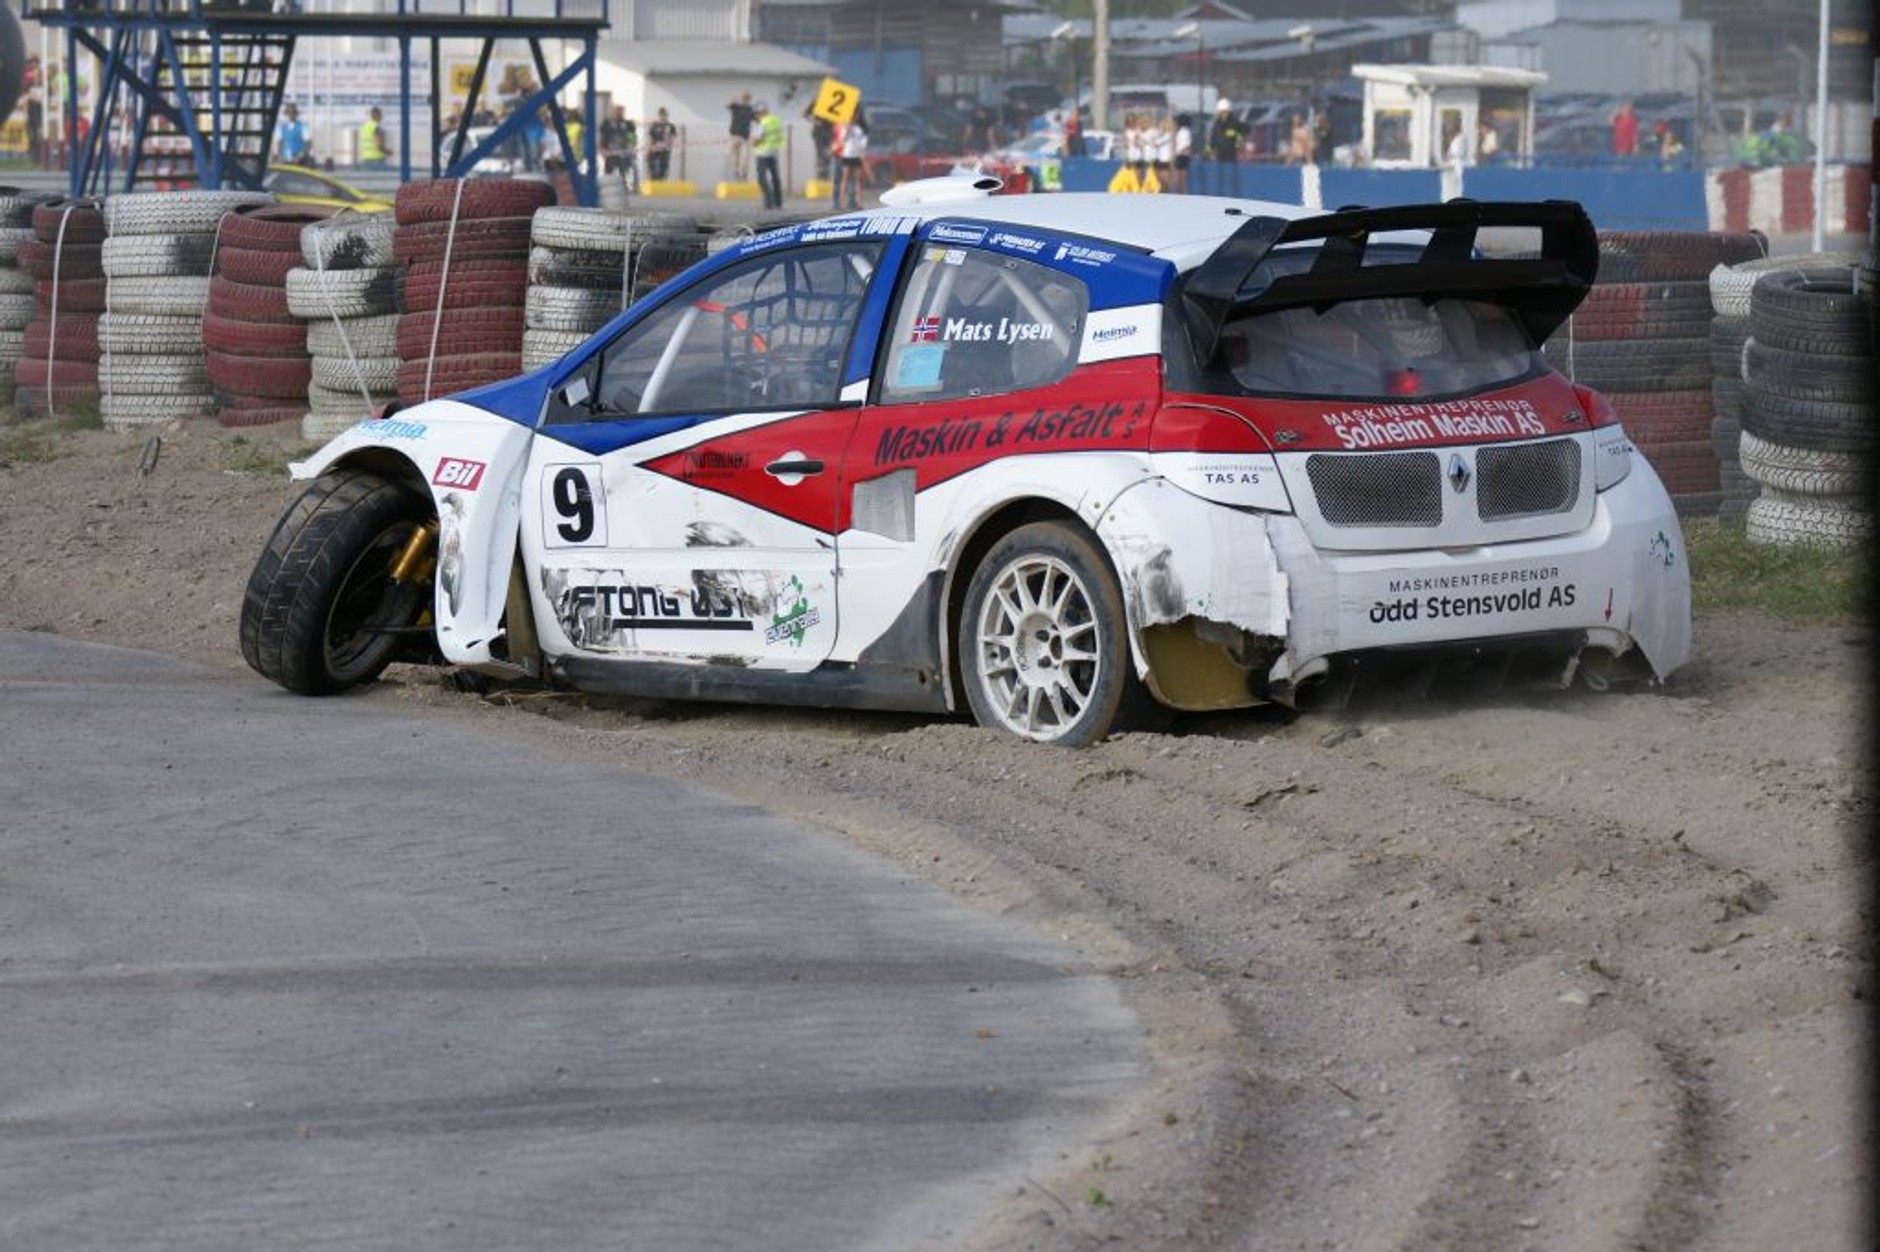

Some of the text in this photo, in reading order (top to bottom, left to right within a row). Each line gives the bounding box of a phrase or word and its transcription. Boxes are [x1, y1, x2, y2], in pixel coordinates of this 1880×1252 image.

[827, 90, 846, 117] 2
[943, 317, 1053, 345] Mats Lysen
[1322, 400, 1534, 427] MASKINENTREPRENØR
[874, 416, 984, 466] Maskin
[985, 411, 1015, 448] &
[1014, 403, 1125, 443] Asfalt
[1335, 411, 1545, 449] Solheim Maskin AS
[436, 460, 477, 487] Bil
[1205, 473, 1259, 484] TAS AS
[553, 467, 595, 542] 9
[1389, 567, 1559, 593] MASKINENTREPRENØR
[1369, 584, 1576, 624] Odd Stensvold AS
